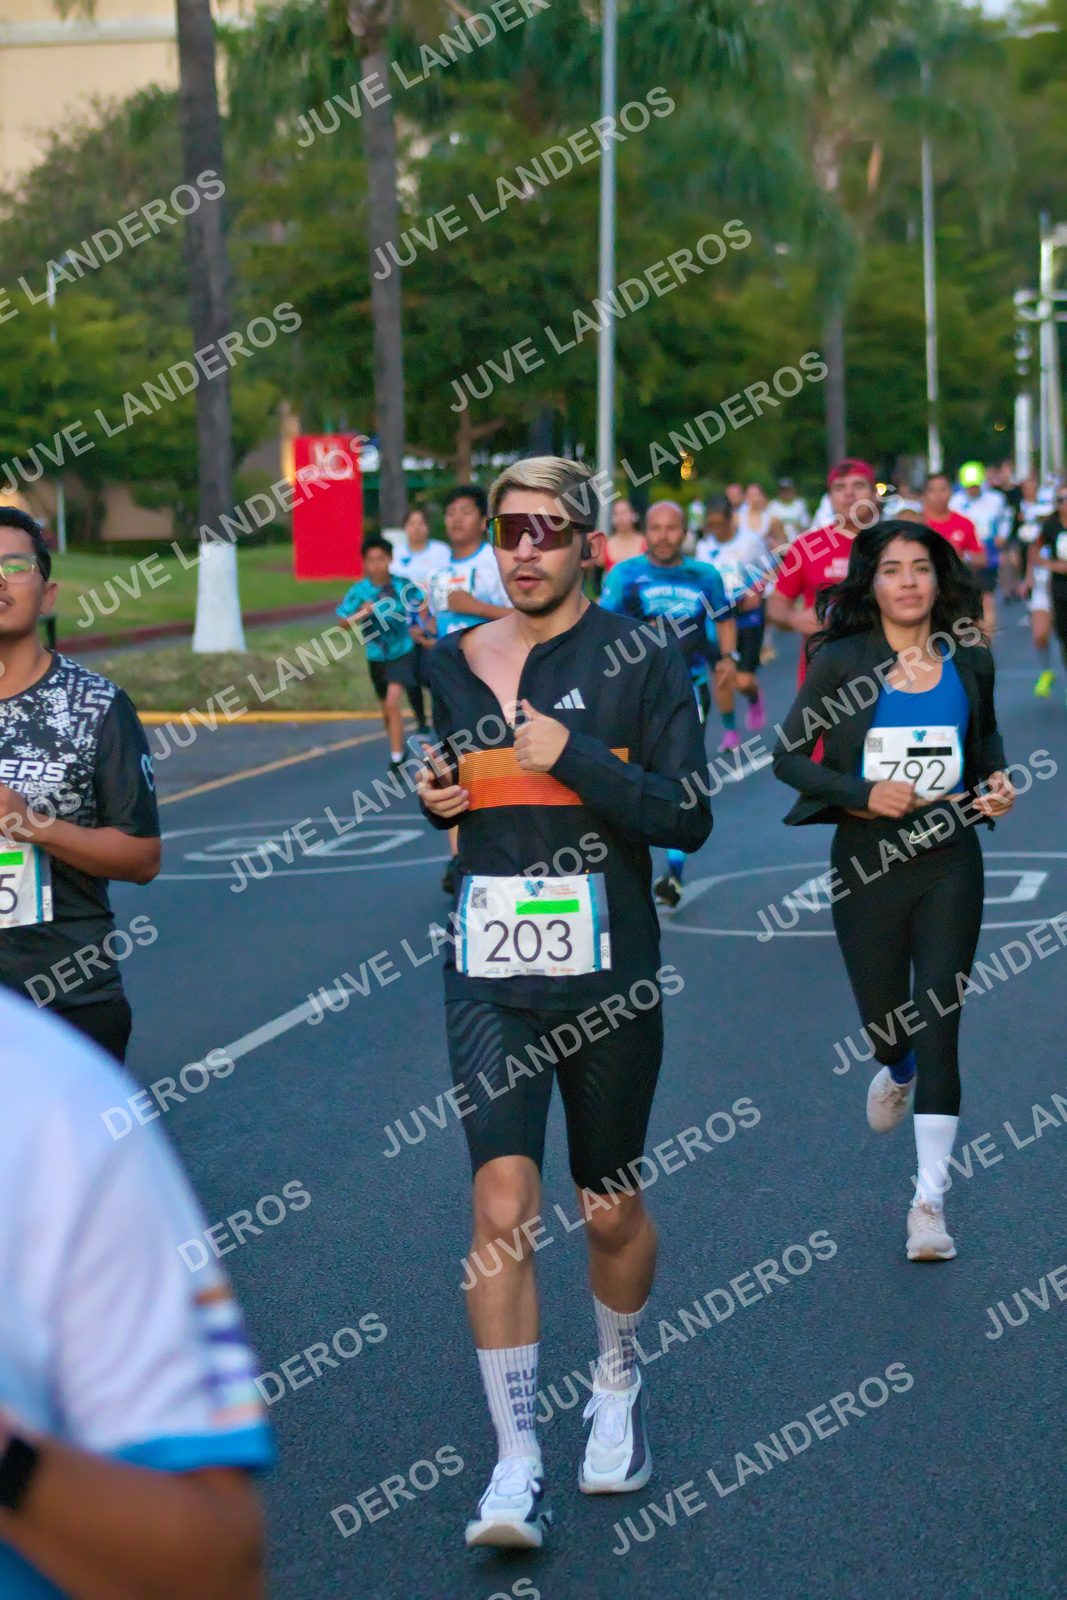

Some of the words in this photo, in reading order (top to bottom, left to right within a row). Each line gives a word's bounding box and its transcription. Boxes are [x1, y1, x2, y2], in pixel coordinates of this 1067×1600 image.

[0, 759, 67, 782] ERS
[880, 760, 946, 790] 792
[484, 920, 572, 962] 203
